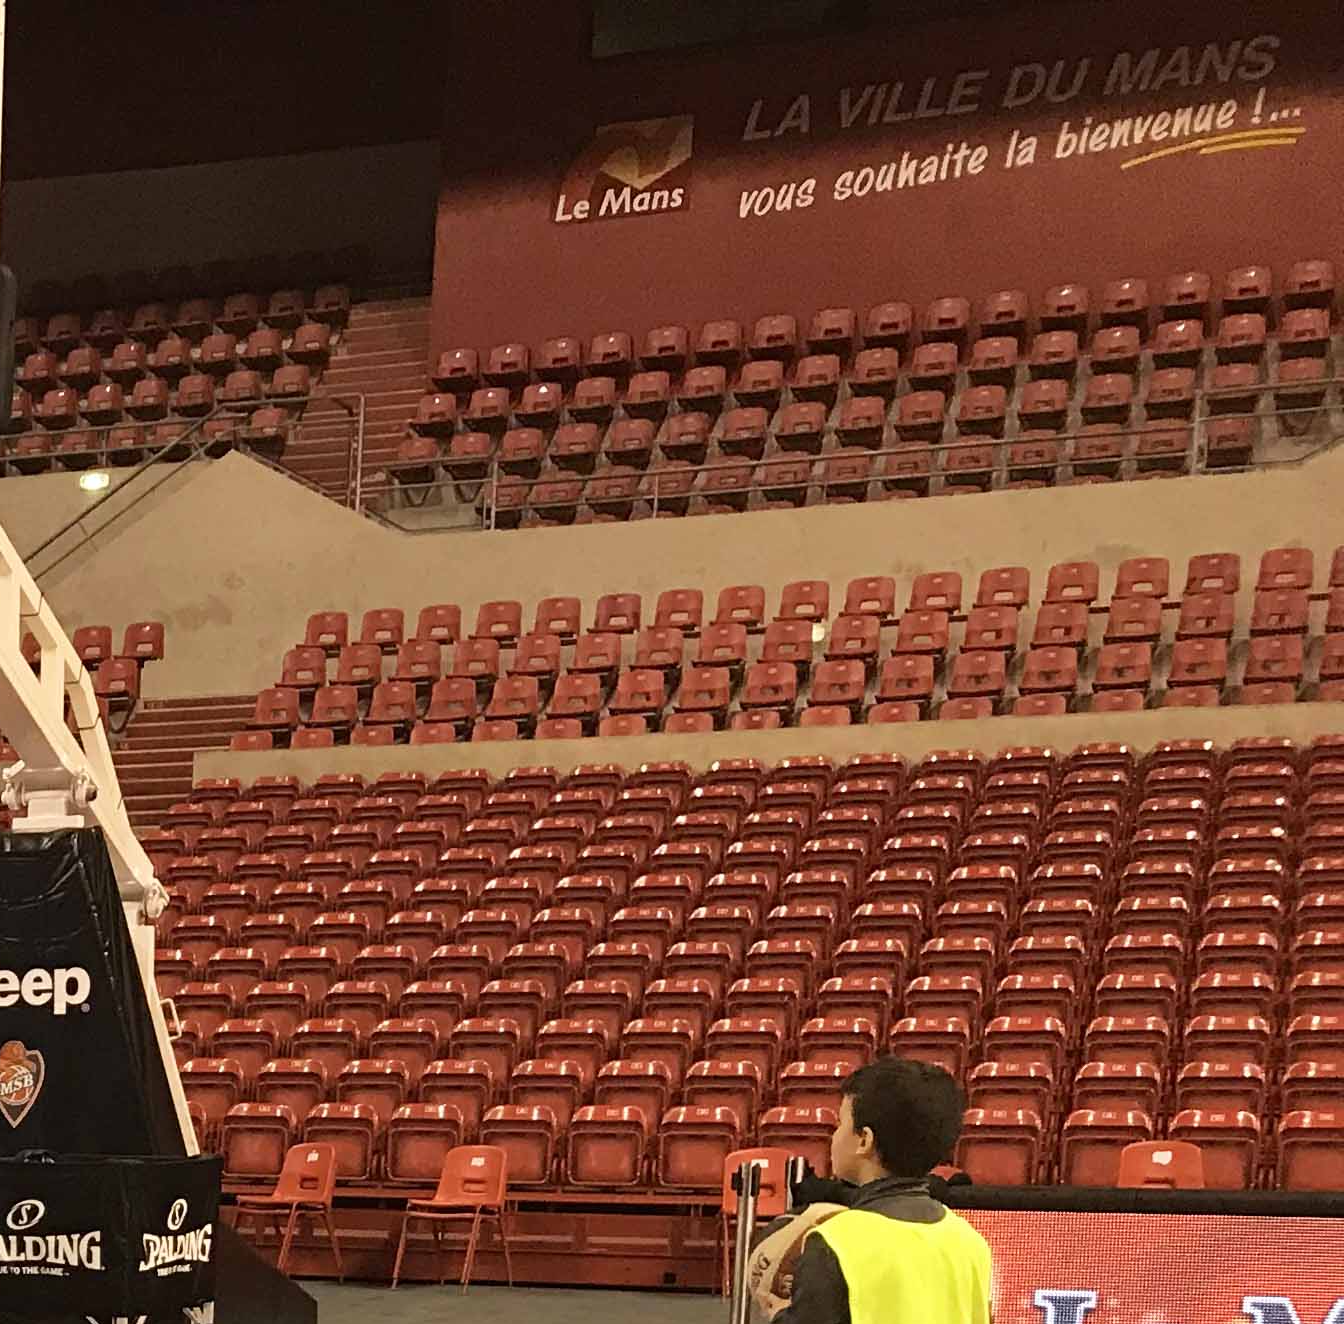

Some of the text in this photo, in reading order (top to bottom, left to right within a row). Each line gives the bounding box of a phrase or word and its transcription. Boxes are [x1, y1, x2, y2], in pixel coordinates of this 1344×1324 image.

[742, 34, 1281, 141] LA VILLE DU MANS
[739, 178, 816, 219] vous
[833, 142, 989, 201] souhaite
[1004, 129, 1038, 168] la
[1055, 99, 1237, 159] bienvenue
[554, 186, 685, 222] Le Mans
[0, 1074, 34, 1096] MSB
[138, 1223, 213, 1273] SPALDING
